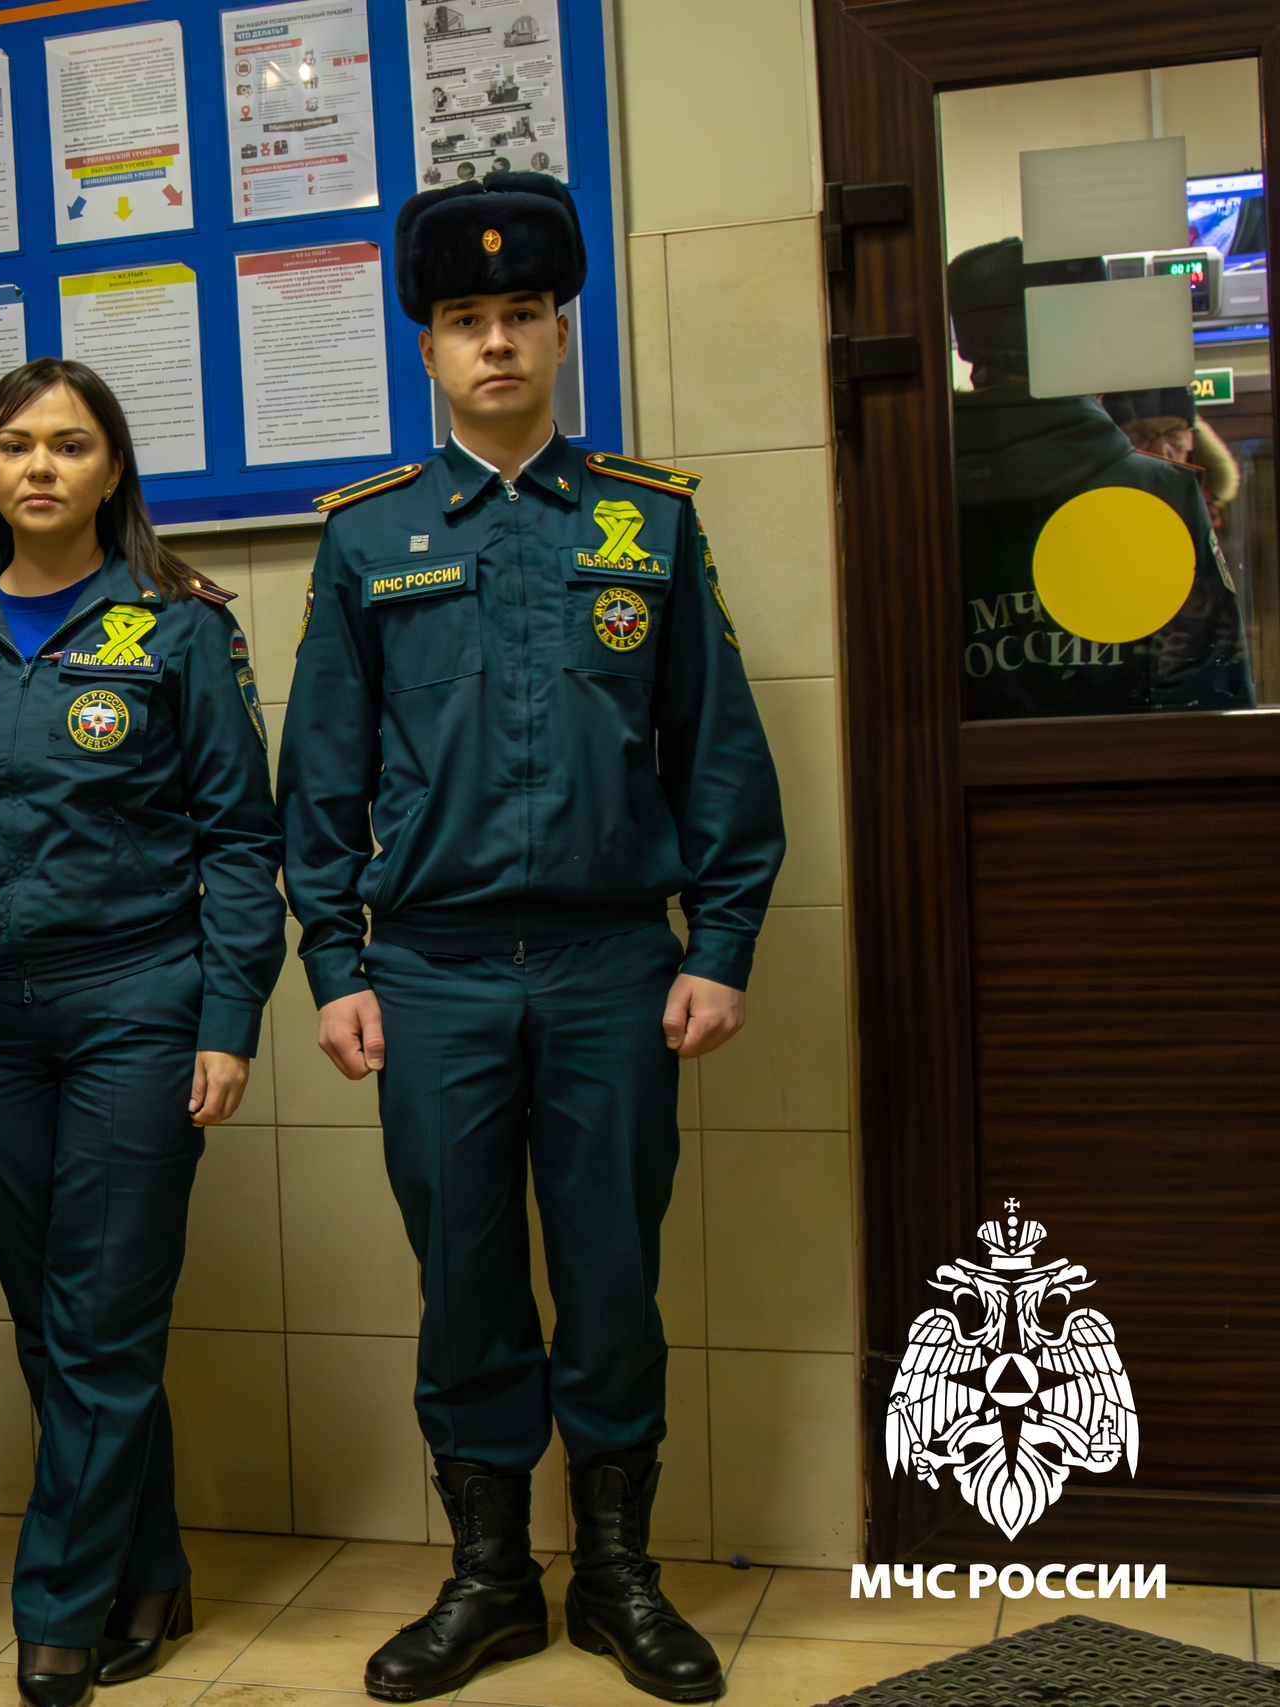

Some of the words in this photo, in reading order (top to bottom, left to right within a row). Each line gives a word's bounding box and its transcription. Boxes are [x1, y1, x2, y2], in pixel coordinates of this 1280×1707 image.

[236, 32, 251, 40] ЧТО
[252, 27, 284, 38] ДЕЛАТЬ?
[373, 577, 403, 594] МЧС
[406, 566, 460, 588] РОССИИ
[639, 560, 665, 574] А.А.
[595, 595, 609, 617] МЧС
[609, 590, 645, 615] РОССИИ
[596, 621, 646, 648] EMERCOM
[72, 696, 89, 716] МЧС
[91, 692, 126, 718] РОССИИ
[74, 728, 123, 748] EMERCOM
